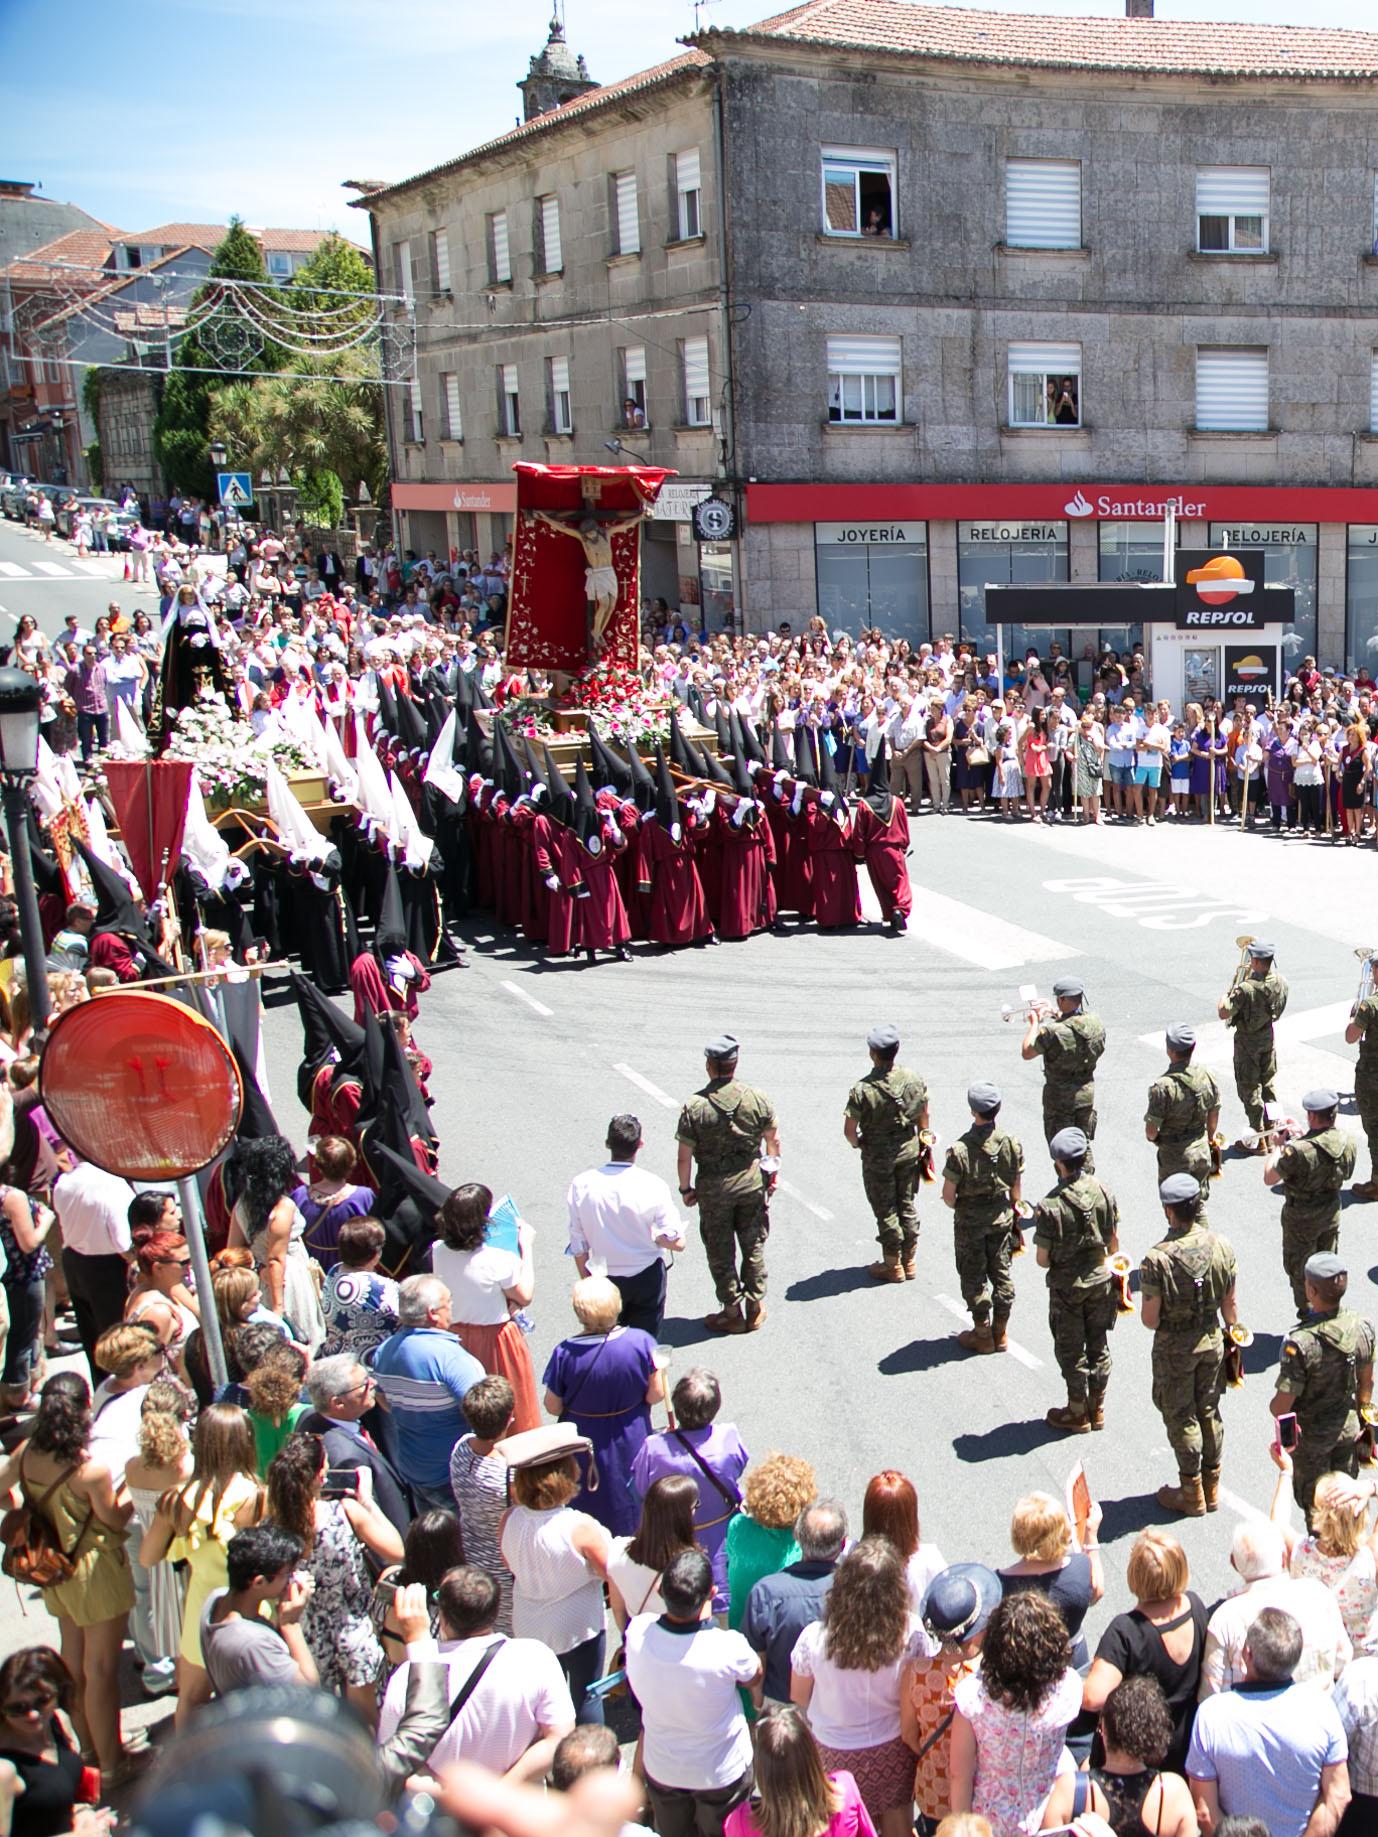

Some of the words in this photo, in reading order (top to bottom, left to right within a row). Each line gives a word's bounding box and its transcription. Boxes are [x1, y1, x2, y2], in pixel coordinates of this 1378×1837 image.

[461, 490, 491, 508] Santander
[1097, 495, 1207, 517] Santander
[837, 525, 906, 542] JOYERÍA
[970, 527, 1057, 541] RELOJERÍA
[1221, 527, 1307, 542] RELOJERÍA
[1185, 611, 1255, 624] REPSOL
